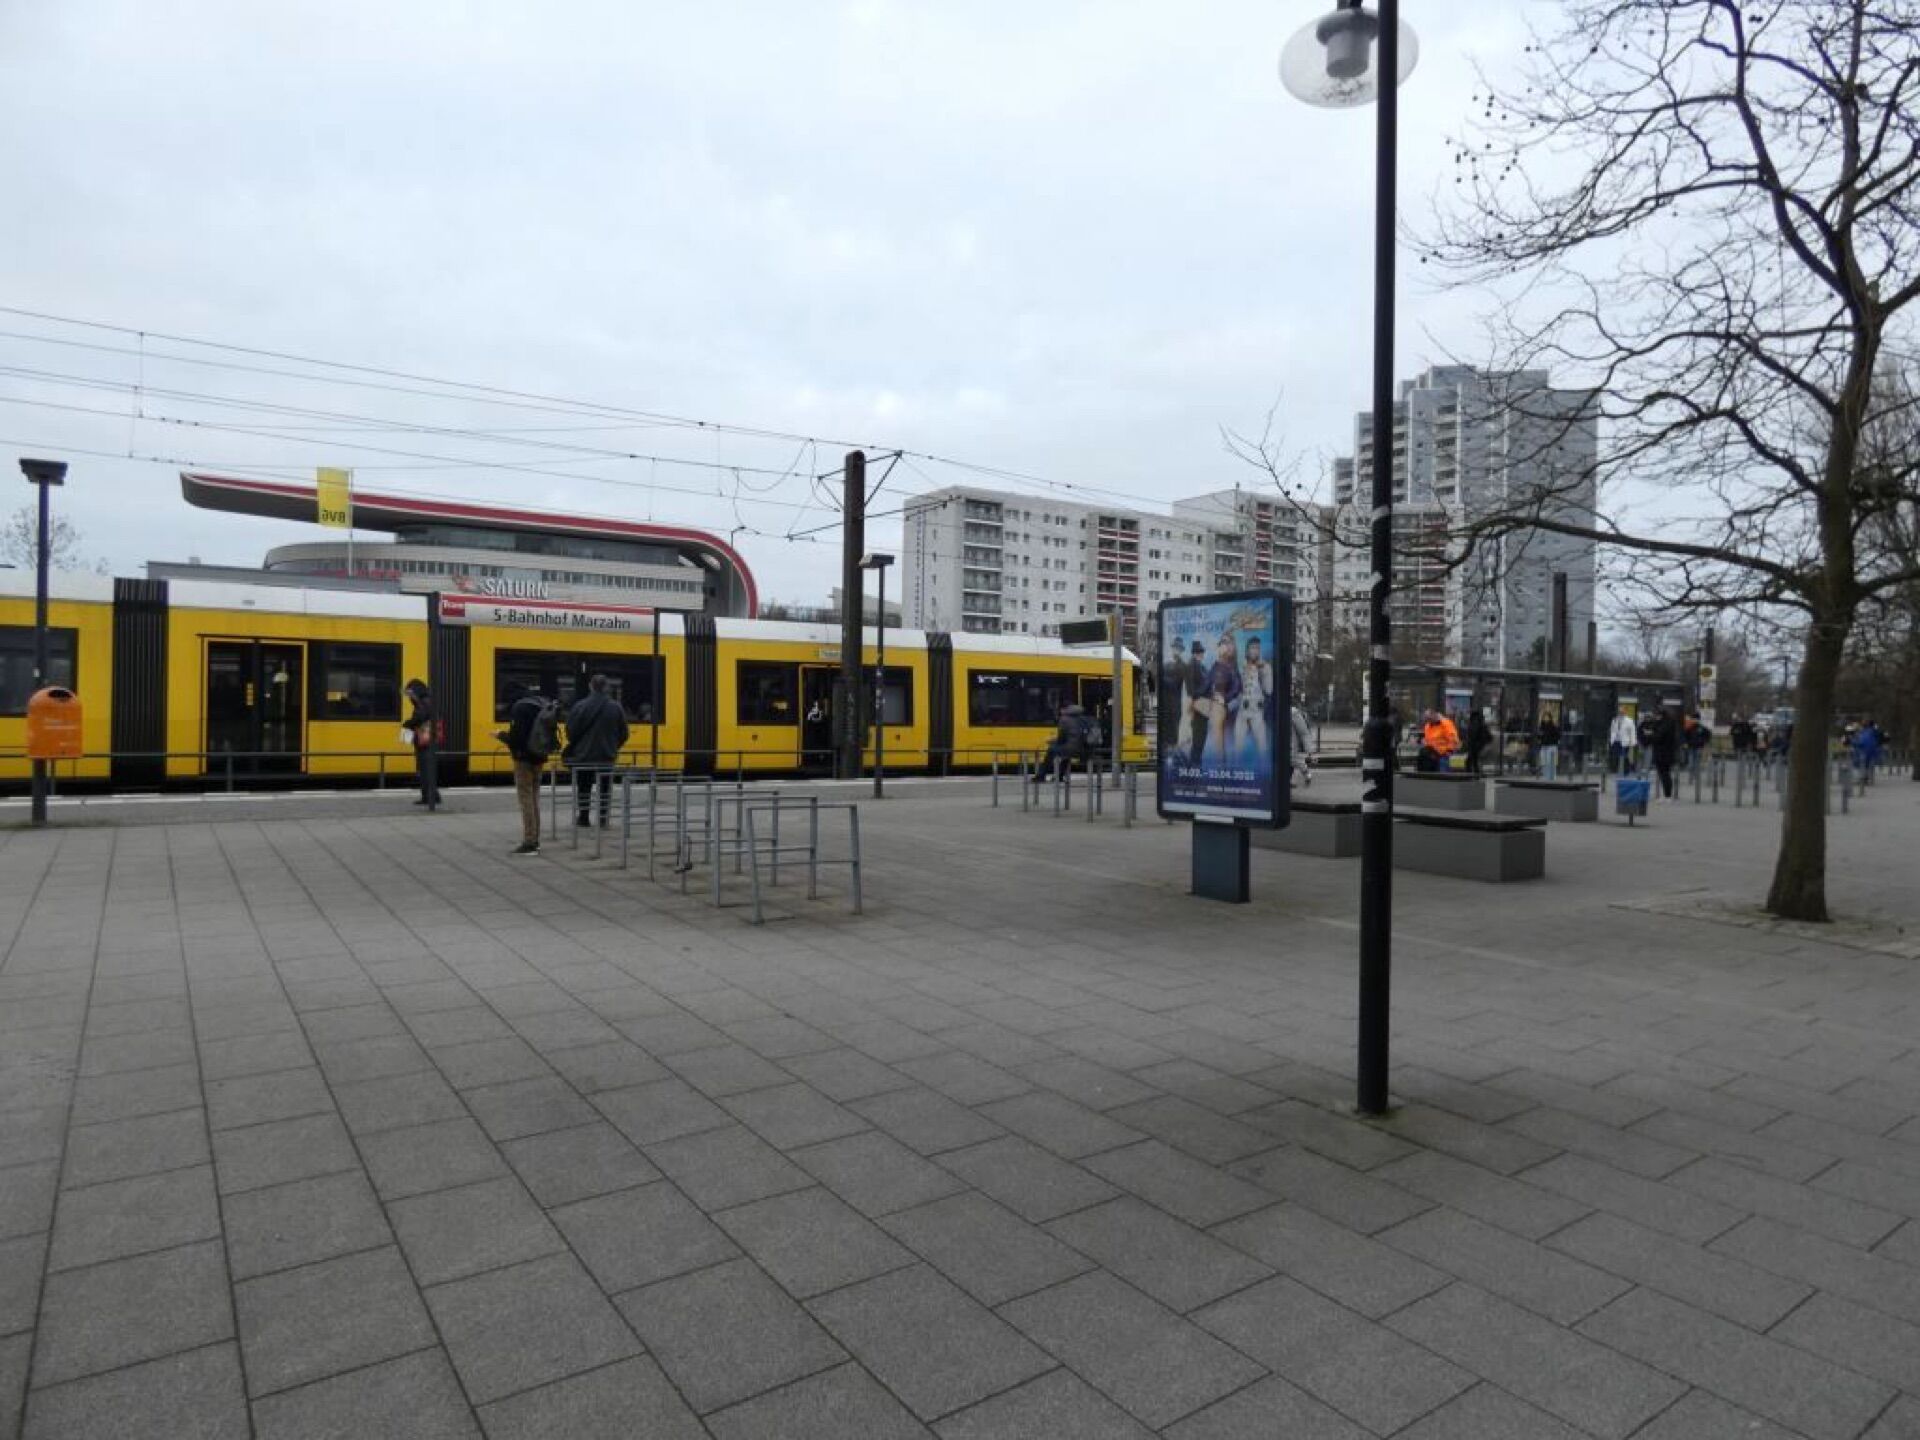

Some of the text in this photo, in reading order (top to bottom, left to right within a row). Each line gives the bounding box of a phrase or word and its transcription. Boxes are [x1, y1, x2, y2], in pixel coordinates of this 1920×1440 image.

[483, 576, 549, 598] SATURN
[493, 608, 631, 629] S-Bahnhof Marzahn
